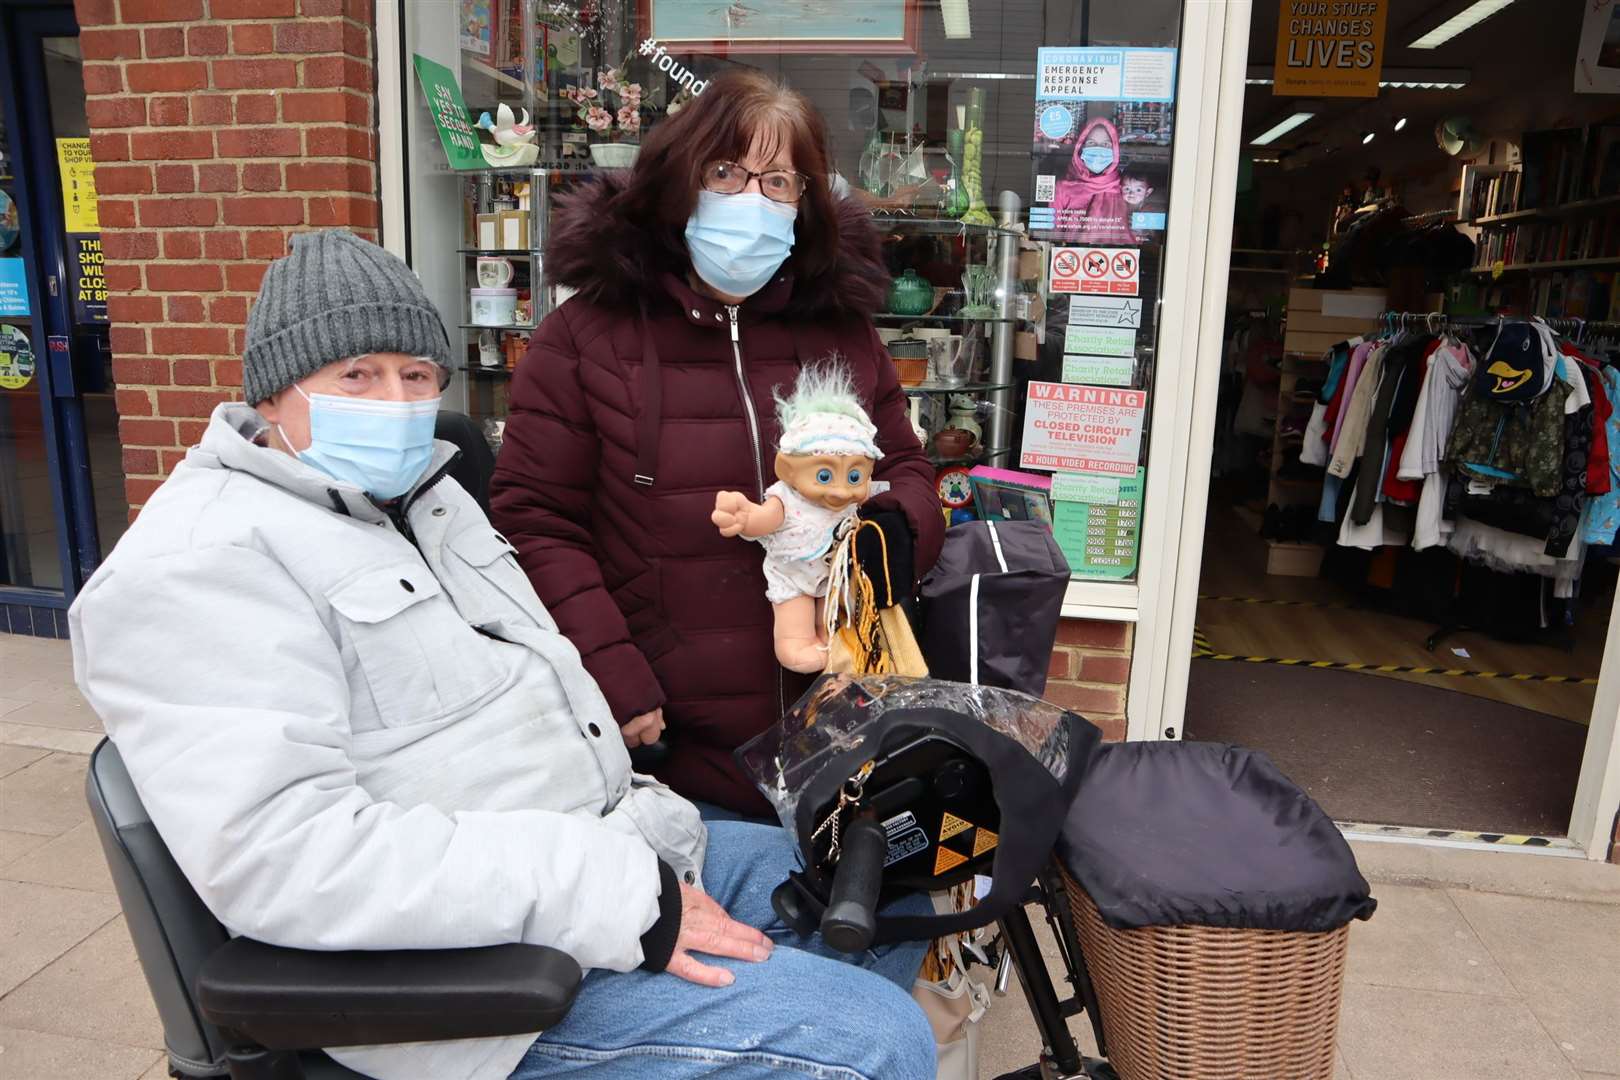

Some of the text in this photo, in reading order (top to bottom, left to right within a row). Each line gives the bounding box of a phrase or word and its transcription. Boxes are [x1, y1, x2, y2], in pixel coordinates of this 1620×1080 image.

[1291, 3, 1377, 16] YOUR STUFF
[1290, 19, 1373, 36] CHANGES
[1287, 39, 1375, 68] LIVES
[1045, 65, 1105, 74] EMERGENCY
[1044, 75, 1098, 84] RESPONSE
[434, 84, 452, 101] SAY
[1044, 85, 1084, 94] APPEAL
[449, 131, 474, 149] HAND
[80, 240, 101, 251] THI
[79, 252, 104, 264] SHO
[82, 265, 104, 276] WIL
[79, 277, 107, 289] CLOS
[79, 290, 109, 301] AT 8P
[1064, 364, 1100, 375] Charity
[1035, 384, 1138, 406] WARNING
[1033, 400, 1137, 418] THESE PREMISES ARE
[1047, 411, 1121, 425] PROTECTED BY
[1034, 419, 1133, 437] CLOSED CIRCUIT
[1047, 431, 1117, 446] TELEVISION
[1023, 454, 1136, 474] 24 HOUR VIDEO RECORDING
